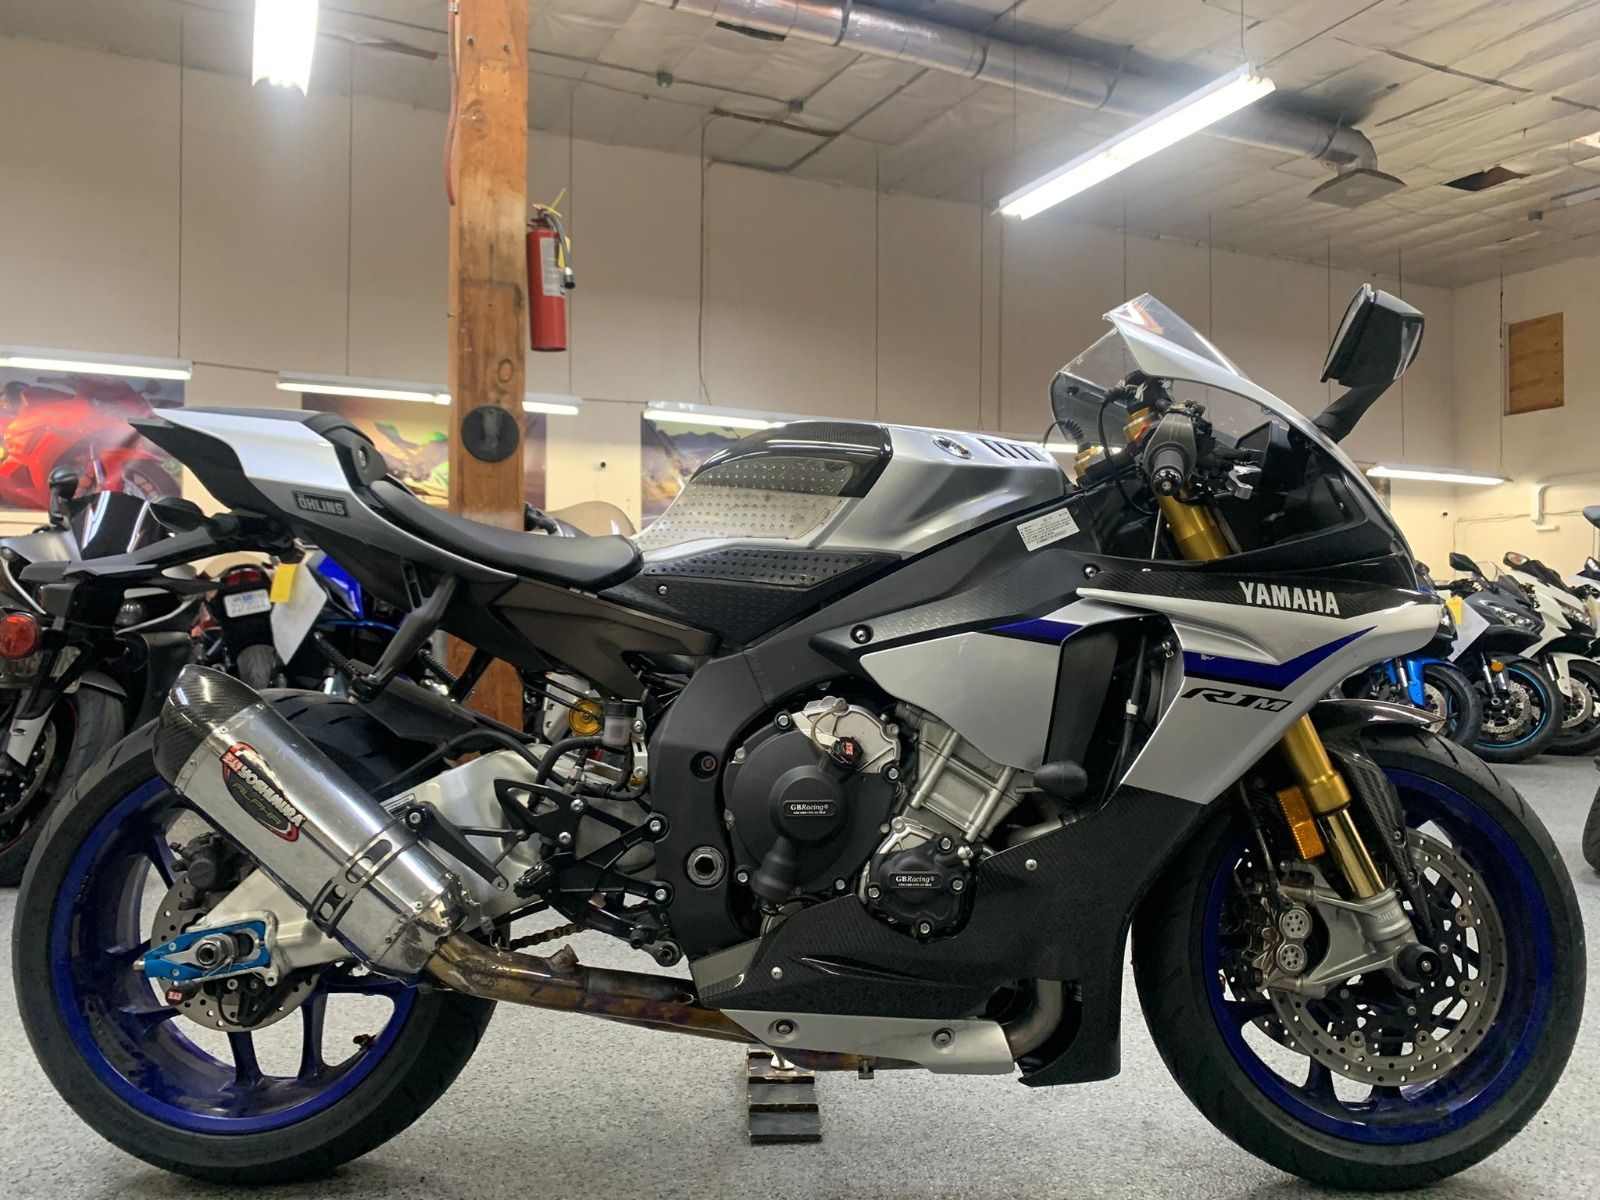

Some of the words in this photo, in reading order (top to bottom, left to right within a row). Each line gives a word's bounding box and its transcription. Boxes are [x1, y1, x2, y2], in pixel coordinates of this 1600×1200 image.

[1238, 581, 1340, 616] YAMAHA
[232, 782, 283, 826] ALPHA
[237, 764, 304, 828] YOSHIMURA
